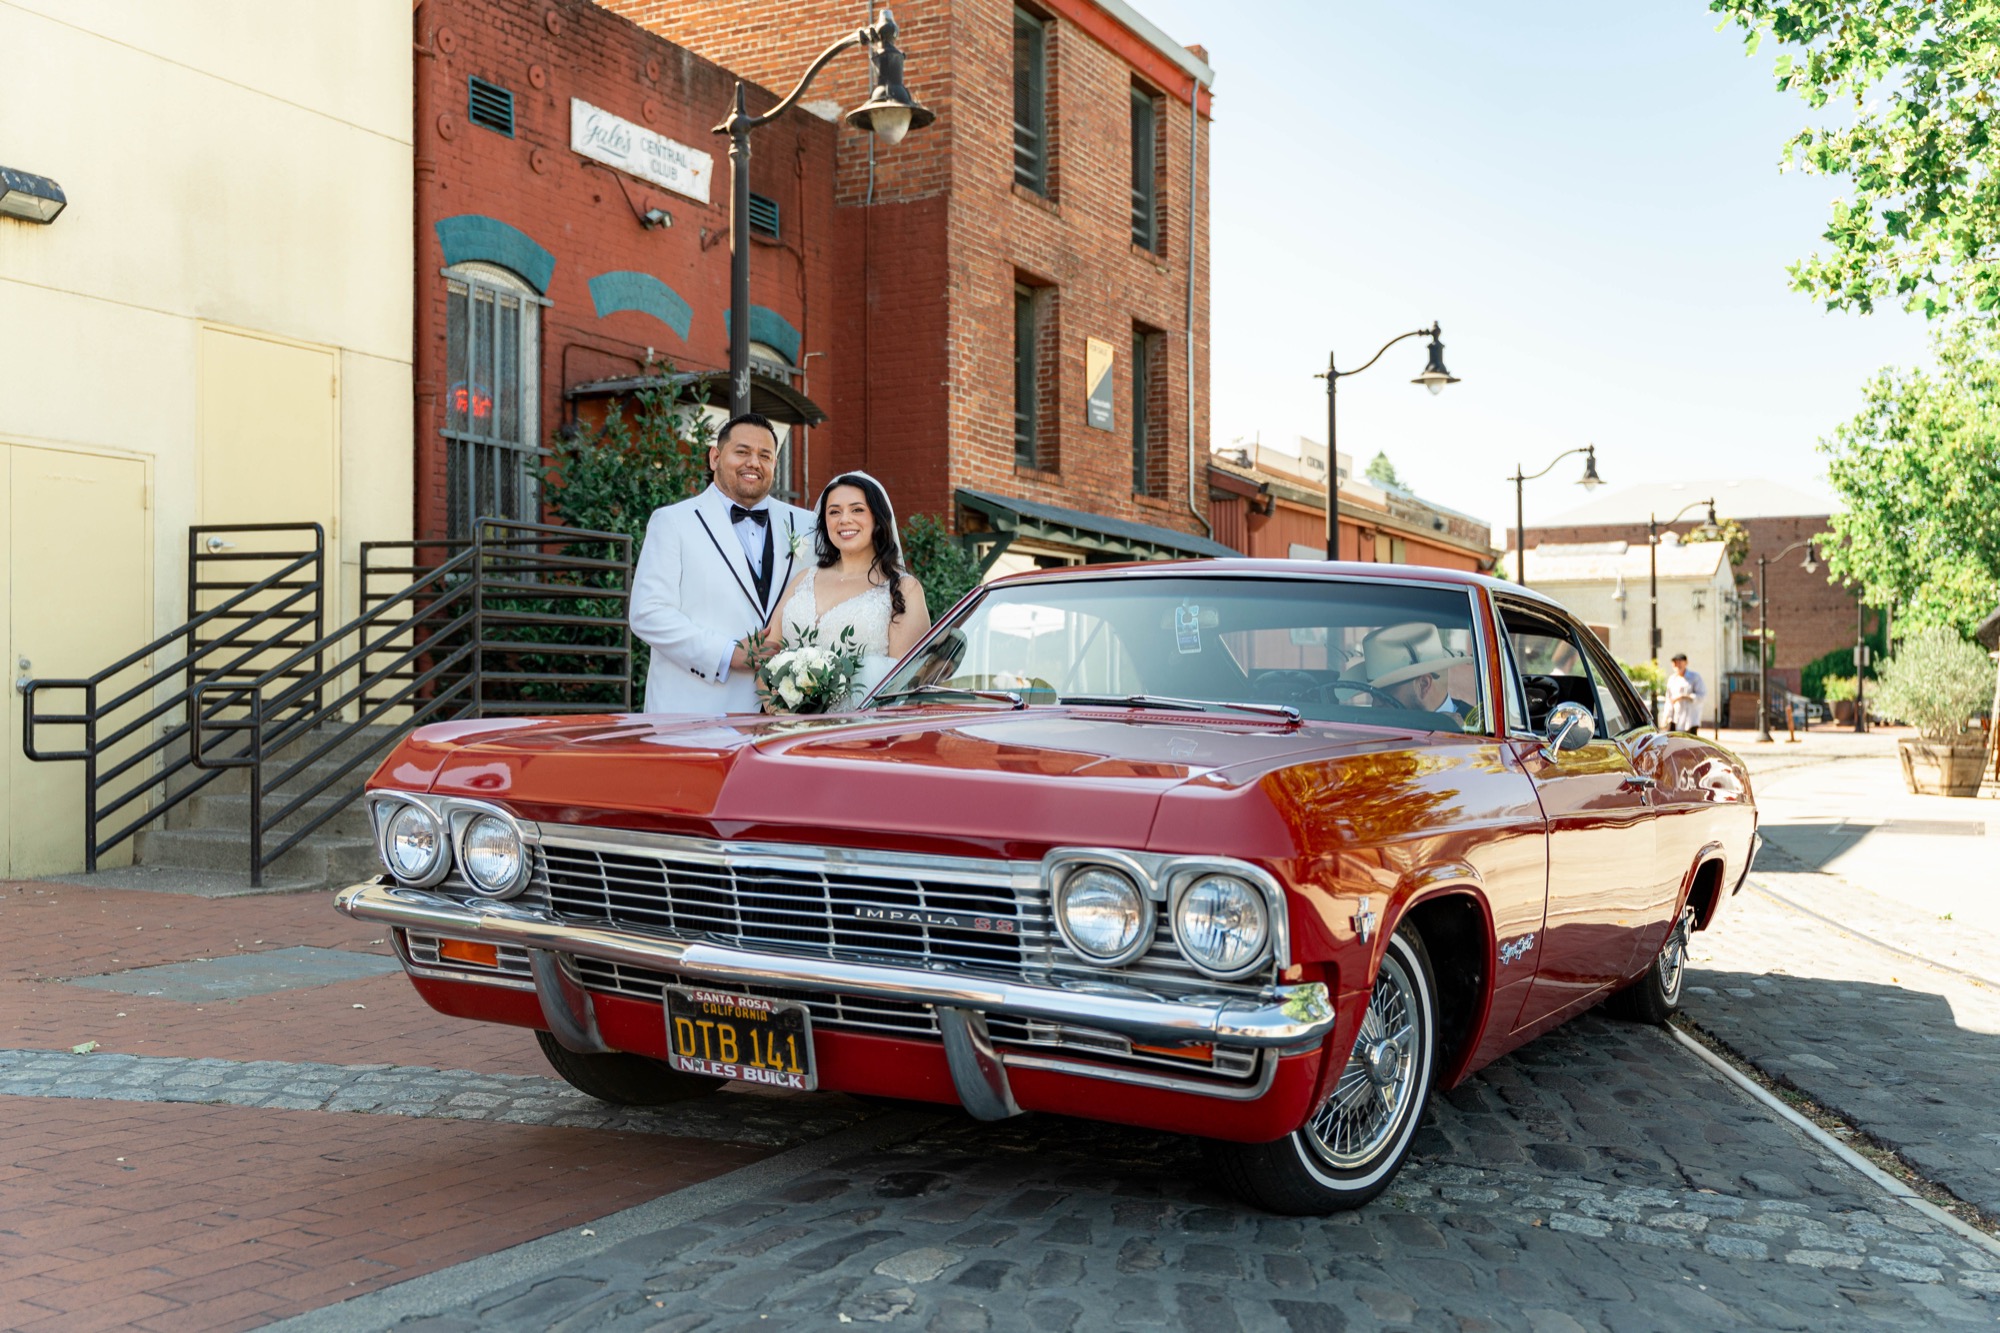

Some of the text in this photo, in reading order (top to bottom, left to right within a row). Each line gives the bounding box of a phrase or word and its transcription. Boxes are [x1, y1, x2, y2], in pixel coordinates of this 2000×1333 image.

[641, 137, 688, 168] CENTRAL
[650, 158, 678, 181] CLUB
[855, 907, 1015, 933] IMPALA SS
[696, 991, 771, 1011] SANTA ROSA
[702, 1003, 768, 1022] CALIFORNIA
[675, 1017, 804, 1074] DTB 141
